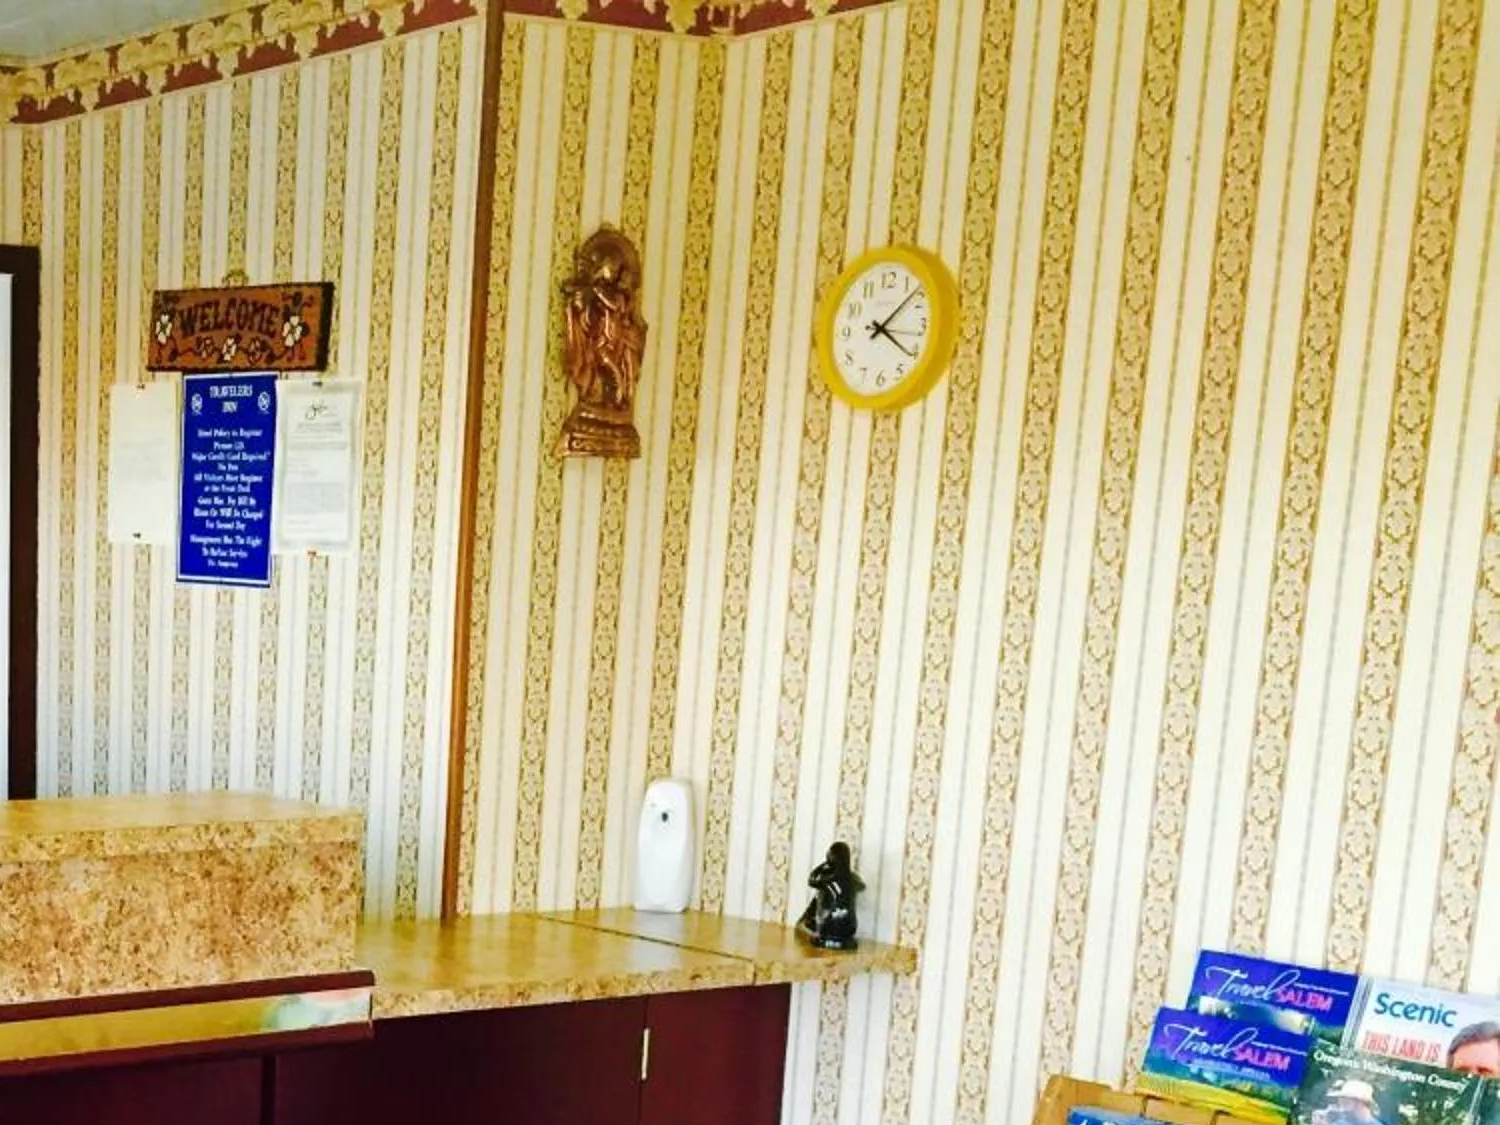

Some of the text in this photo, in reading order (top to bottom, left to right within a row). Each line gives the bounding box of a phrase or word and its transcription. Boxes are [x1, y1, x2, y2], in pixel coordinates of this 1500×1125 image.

[881, 271, 897, 289] 12
[863, 281, 875, 299] 11
[180, 297, 280, 338] WELCOME
[848, 302, 862, 319] 10
[842, 326, 851, 341] 9
[844, 350, 854, 367] 8
[859, 366, 868, 385] 7
[875, 369, 886, 388] 6
[894, 363, 904, 381] 5
[1205, 966, 1334, 1012] Travel SALEM
[1374, 993, 1457, 1028] Scenic
[1164, 1023, 1259, 1060] Travel
[1233, 1044, 1292, 1071] SALEM
[1362, 1031, 1391, 1053] THIS
[1392, 1036, 1422, 1061] LAND
[1425, 1042, 1441, 1062] IS
[1362, 1058, 1426, 1083] Washington
